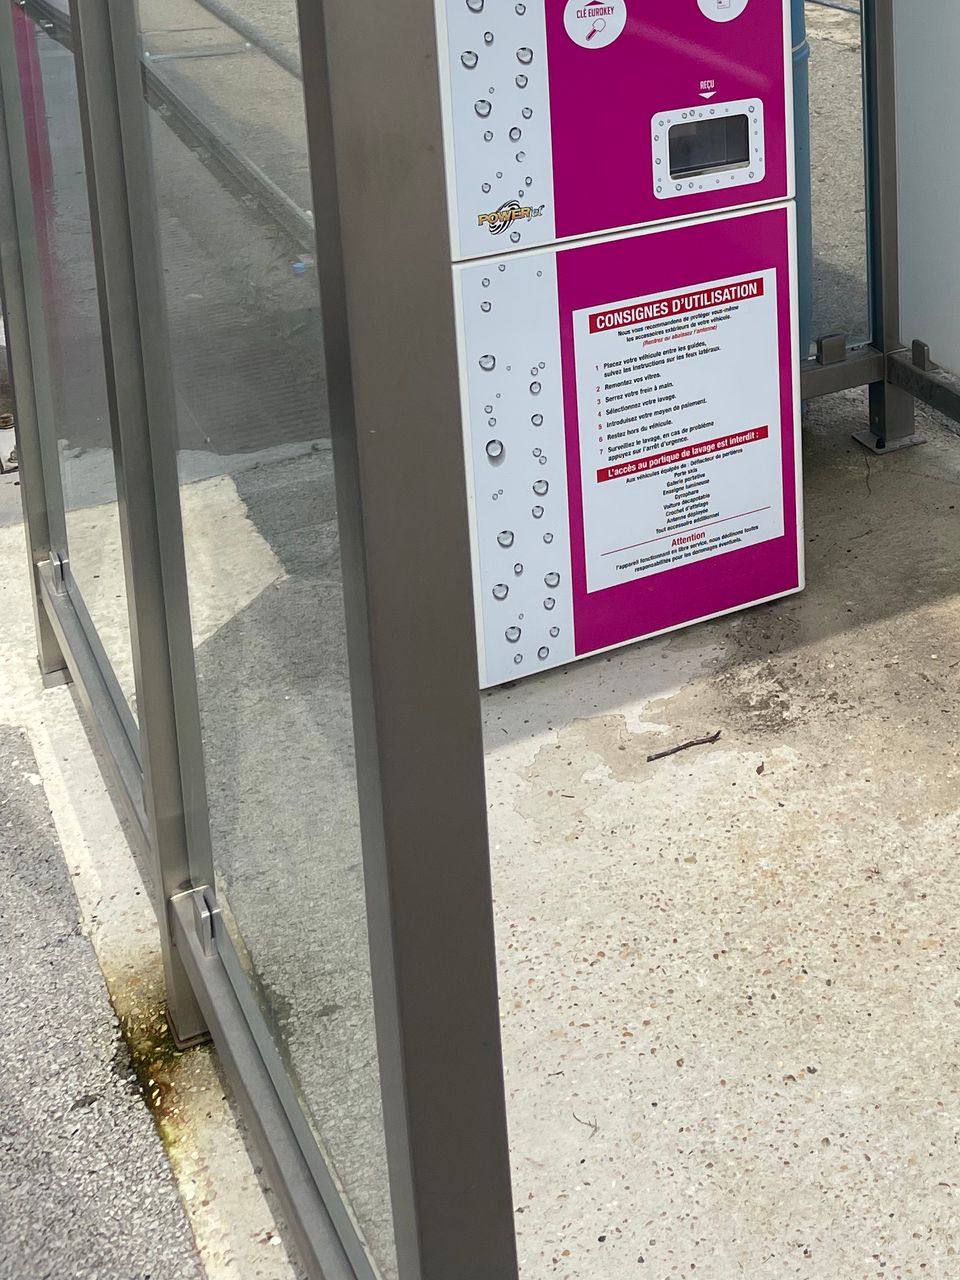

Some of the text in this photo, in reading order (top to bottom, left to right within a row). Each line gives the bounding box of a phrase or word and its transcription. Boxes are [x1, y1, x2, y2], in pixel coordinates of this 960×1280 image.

[577, 6, 614, 18] CLÉ EUROKEY
[700, 80, 715, 90] REÇU
[596, 301, 668, 329] CONSIGNES
[637, 460, 646, 470] au
[648, 451, 679, 467] portique
[681, 448, 690, 459] de
[692, 442, 715, 456] lavage
[716, 439, 727, 450] est
[729, 432, 754, 446] interdit
[671, 530, 705, 547] Attention
